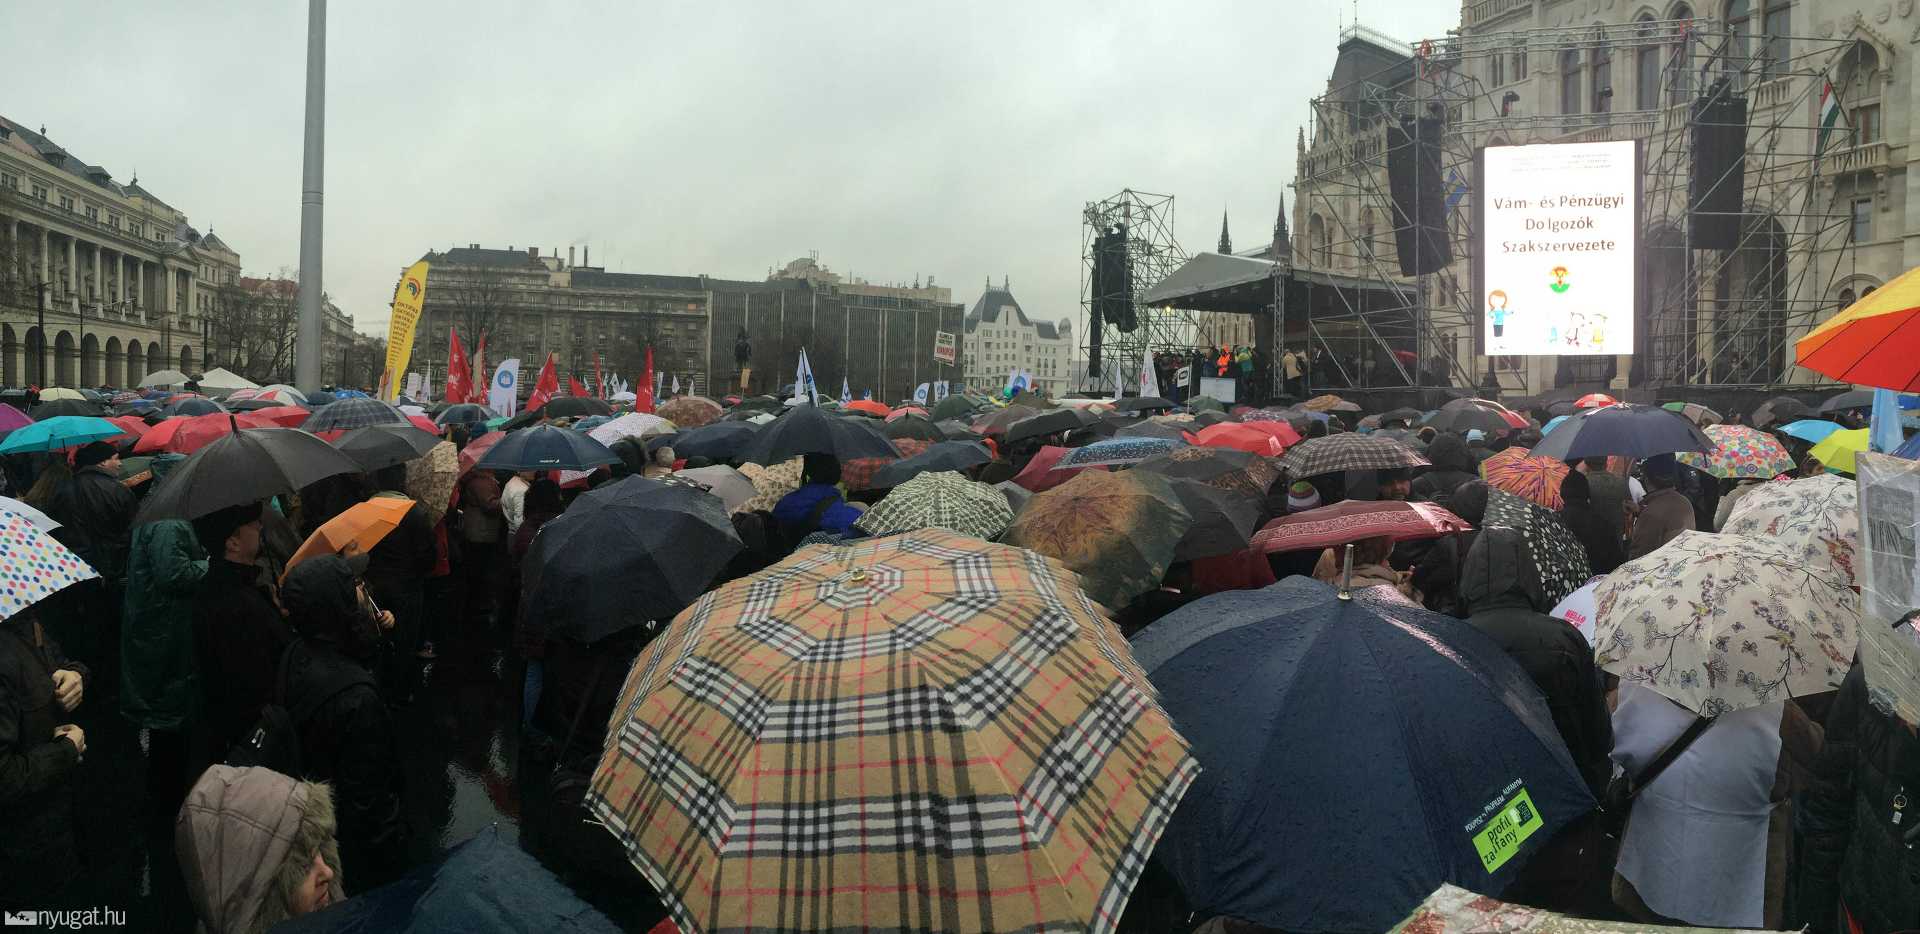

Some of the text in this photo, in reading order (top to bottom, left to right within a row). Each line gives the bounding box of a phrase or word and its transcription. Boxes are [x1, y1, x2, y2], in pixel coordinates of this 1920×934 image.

[1493, 192, 1625, 210] Vám- és Pénzügyi
[1525, 215, 1594, 233] Dolgozók
[1502, 239, 1616, 253] Szakszervezete
[1487, 815, 1512, 844] profil
